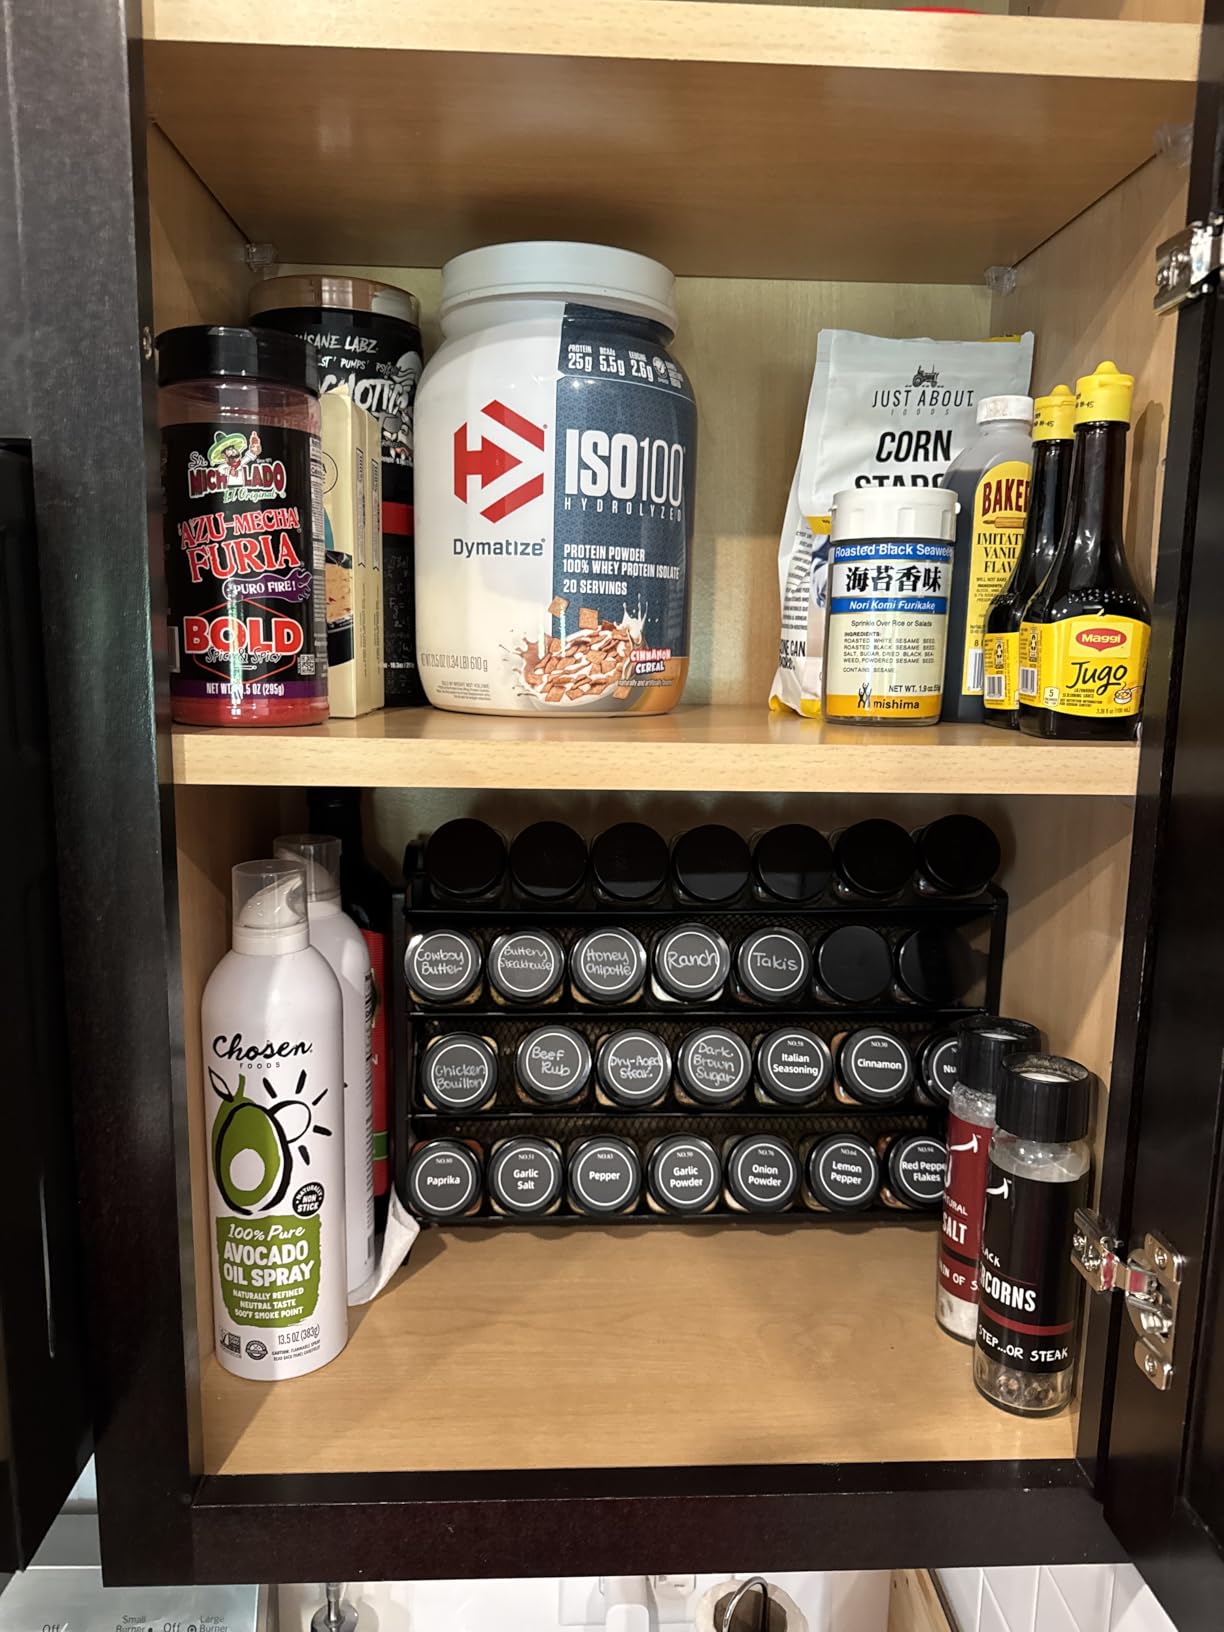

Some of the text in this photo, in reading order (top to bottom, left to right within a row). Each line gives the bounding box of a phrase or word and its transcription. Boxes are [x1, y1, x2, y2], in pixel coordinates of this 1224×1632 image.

[568, 344, 593, 353] PROTEIN
[568, 353, 593, 372] 25g
[599, 355, 625, 377] 5.5g
[631, 359, 653, 382] 2.6g
[872, 390, 974, 408] JUST ABOUT
[875, 430, 953, 463] CORN
[565, 429, 684, 507] ISO100
[564, 497, 681, 522] HYDROLYZED
[453, 538, 544, 558] Dymatize
[563, 544, 645, 562] PROTEIN POWDER
[835, 543, 913, 557] Roasted Black
[984, 547, 1018, 559] VANIL
[187, 533, 300, 583] FURIA
[563, 559, 680, 580] 100% WHEY PROTEIN ISOLATE
[984, 561, 1015, 573] FLAV
[267, 580, 296, 592] FIRE!
[845, 565, 942, 593] 海苔香味
[563, 579, 628, 595] 20 SERVINGS
[849, 600, 935, 610] Nori Komi Furikake
[183, 616, 304, 655] BOLD
[1081, 633, 1121, 644] Maggi
[630, 648, 672, 661] CINNAMON
[635, 661, 665, 674] CEREAL
[1065, 661, 1128, 696] Jugo
[206, 683, 285, 696] NET OZ (295g)
[1049, 689, 1054, 697] 5
[874, 699, 920, 710] mishima
[416, 948, 464, 965] Cowboy
[504, 945, 548, 962] Buttery
[586, 949, 629, 965] Honey
[667, 950, 719, 969] Ranch
[422, 961, 462, 975] Butter
[753, 952, 798, 971] Takis
[212, 1033, 312, 1060] Chosen
[531, 1046, 565, 1061] Beef
[698, 1043, 734, 1057] Dark
[693, 1054, 735, 1072] Brown
[781, 1053, 810, 1063] Italian
[857, 1058, 902, 1070] Cinnamon
[434, 1064, 486, 1077] Chicken
[541, 1061, 571, 1077] Rub
[772, 1063, 819, 1077] Seasoning
[943, 1064, 957, 1073] Nu
[695, 1067, 736, 1086] Sugar
[513, 1169, 539, 1178] Garlic
[673, 1166, 698, 1177] Garlic
[752, 1164, 778, 1175] Onion
[832, 1161, 862, 1173] Lemon
[902, 1161, 946, 1172] Red Peppe
[427, 1175, 460, 1187] Paprika
[589, 1171, 620, 1182] Pepper
[670, 1177, 703, 1188] Powder
[748, 1176, 782, 1187] Powder
[830, 1172, 862, 1185] Pepper
[913, 1172, 941, 1182] Flakes
[517, 1181, 535, 1190] Salt
[297, 1202, 319, 1212] STICK
[228, 1224, 305, 1241] 100% Pure
[943, 1212, 968, 1244] SALT
[223, 1240, 309, 1266] AVOCADO
[223, 1260, 315, 1287] OIL SPRAY
[952, 1273, 979, 1291] OF S
[232, 1287, 304, 1300] NATURALLY REFINED
[240, 1299, 296, 1310] NEUTRAL TASTE
[254, 1309, 279, 1319] SMOKE
[281, 1306, 303, 1318] POINT
[278, 1324, 320, 1345] 13.5 OZ (383g)
[1030, 1347, 1068, 1362] STEAK
[42, 1624, 60, 1632] Off
[163, 1622, 181, 1632] Off
[122, 1615, 225, 1625] Small Large
